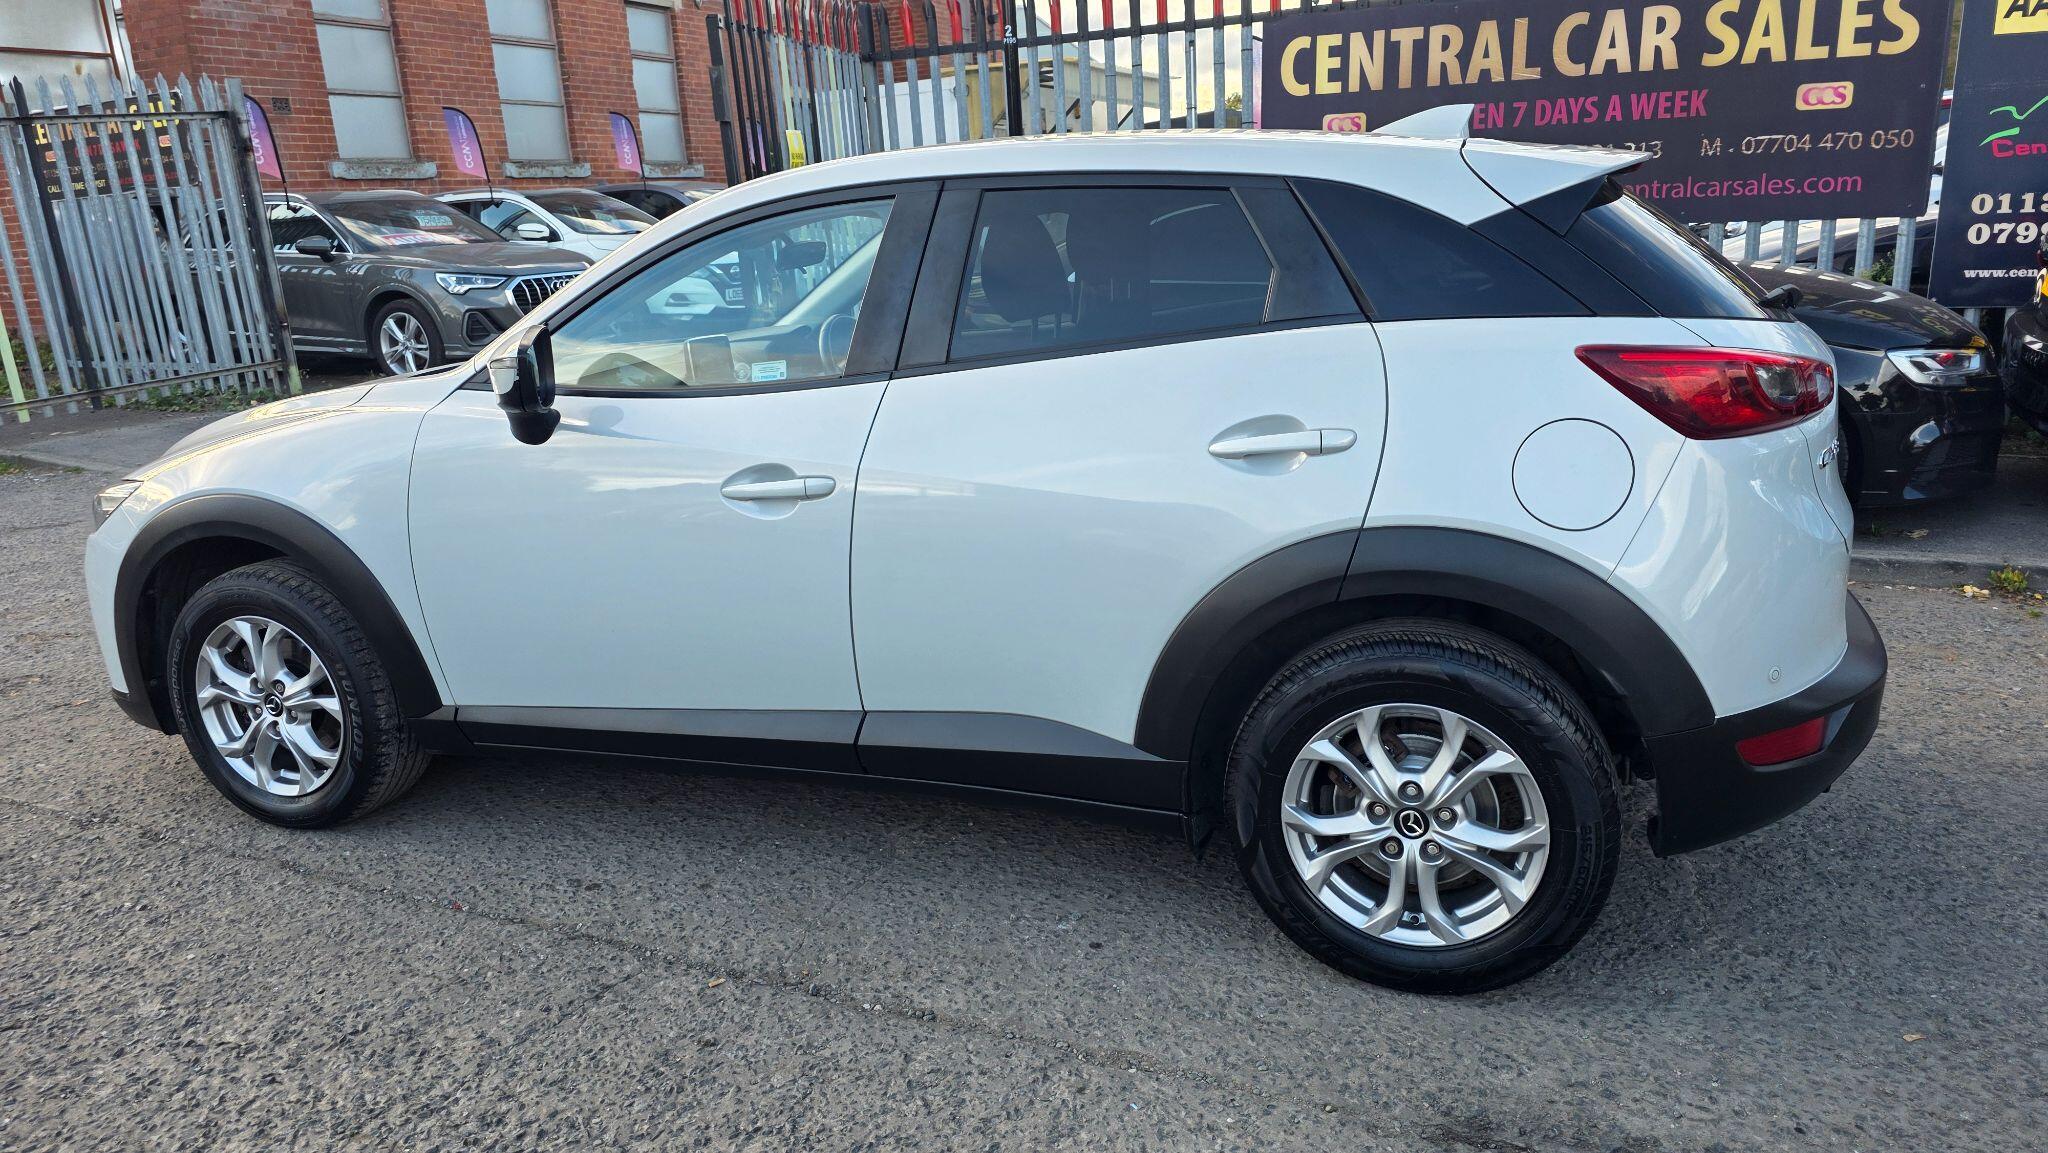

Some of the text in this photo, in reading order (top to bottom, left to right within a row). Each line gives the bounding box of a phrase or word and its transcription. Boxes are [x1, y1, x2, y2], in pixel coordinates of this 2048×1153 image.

[1280, 0, 1920, 97] CENTRAL CAR SALES
[1472, 88, 1710, 130] EN 7 DAYS A WEEK
[1741, 133, 1812, 155] 07704
[1818, 131, 1863, 151] 470
[1870, 128, 1915, 149] 050
[1623, 172, 1863, 199] entralcarsales.com
[1963, 268, 2039, 278] www.cen
